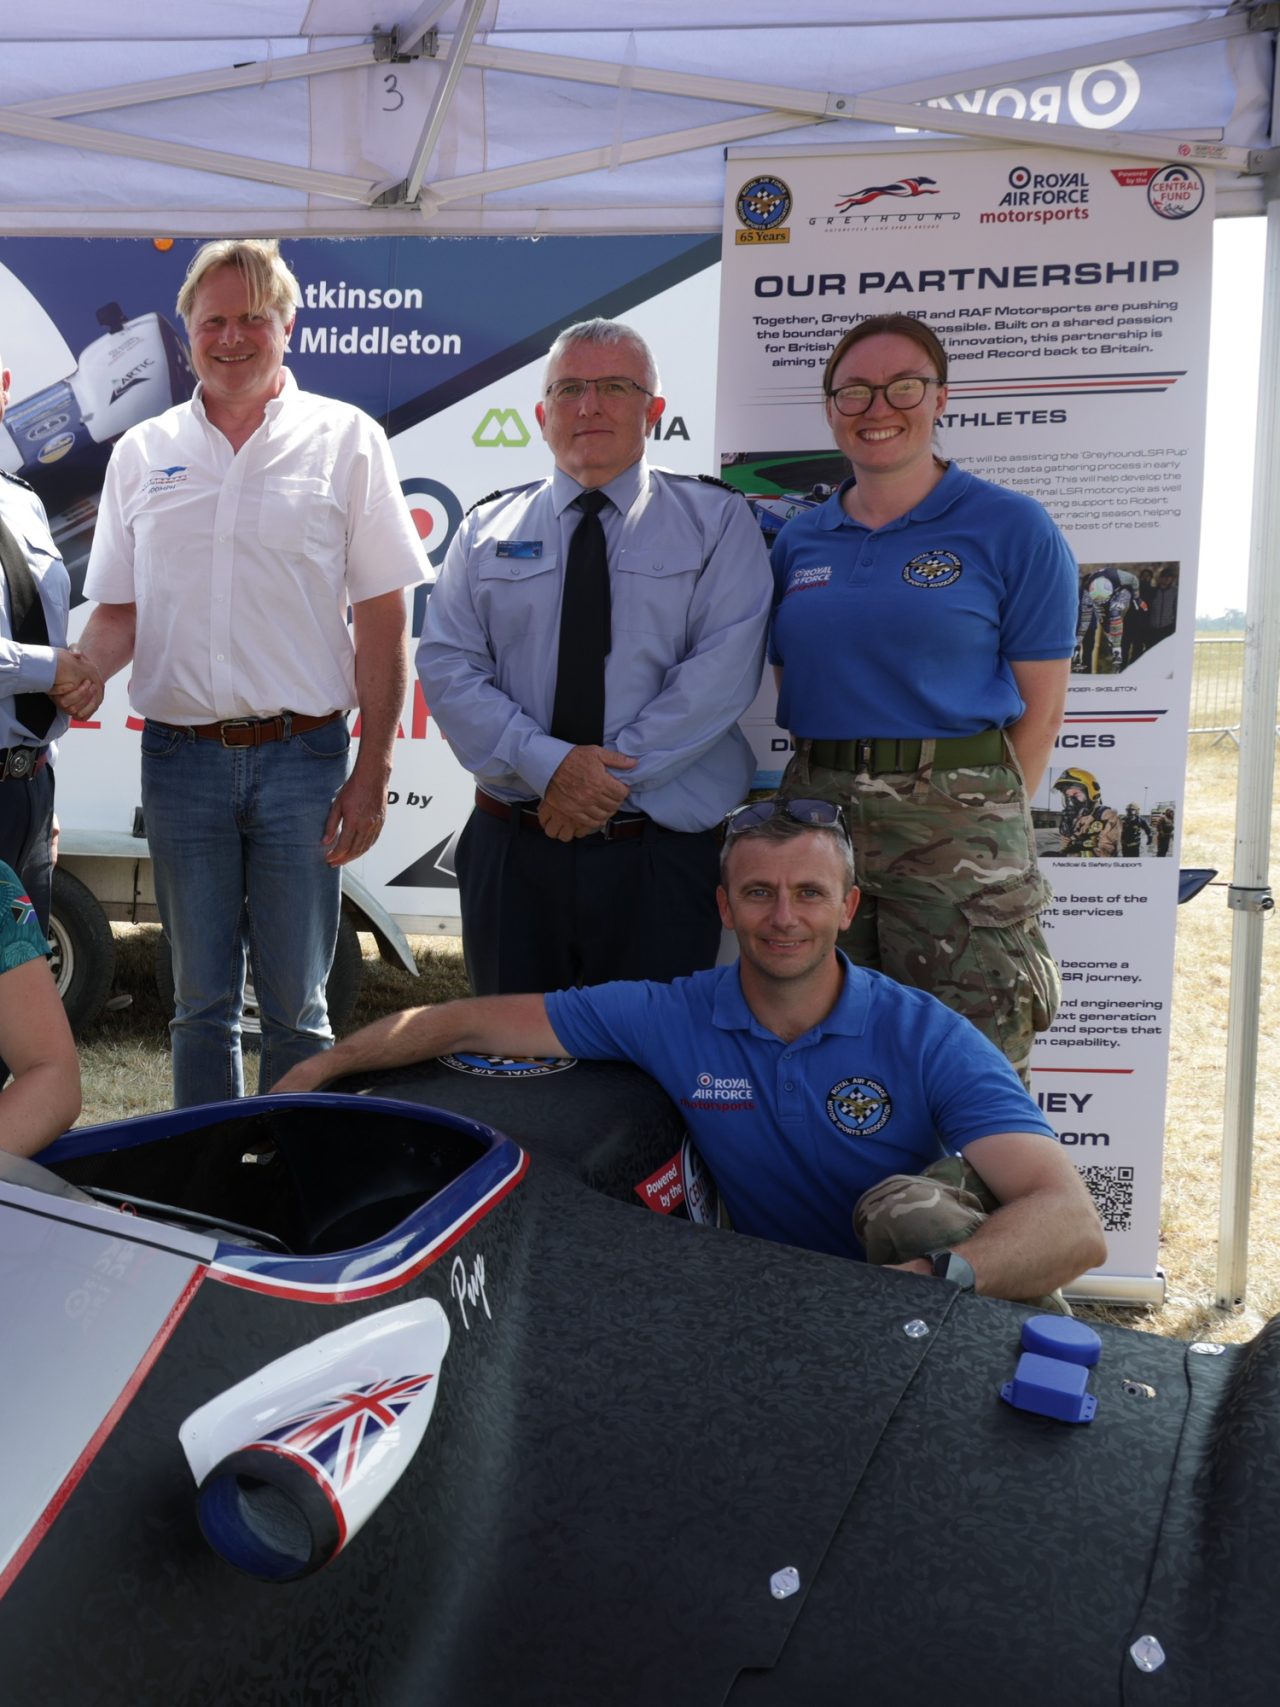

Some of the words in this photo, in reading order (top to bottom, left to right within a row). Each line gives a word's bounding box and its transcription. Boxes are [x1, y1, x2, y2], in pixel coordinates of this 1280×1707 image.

[382, 74, 404, 112] 3
[1033, 173, 1089, 189] ROYAL
[1152, 182, 1200, 193] CENTRAL
[998, 191, 1029, 207] AIR
[1032, 189, 1089, 206] FORCE
[1160, 192, 1191, 202] FUND
[808, 212, 961, 226] GREYHOUND
[979, 207, 1089, 225] motorsports
[740, 232, 754, 242] 65
[756, 231, 786, 241] Years
[754, 273, 847, 298] OUR
[858, 259, 1180, 295] PARTNERSHIP
[753, 315, 819, 328] Together,
[929, 309, 956, 320] and
[958, 307, 992, 319] RAF
[994, 302, 1092, 318] Motorsports
[1094, 303, 1119, 312] are
[1122, 300, 1178, 313] pushing
[757, 329, 780, 339] the
[782, 326, 849, 339] boundari
[995, 318, 1029, 332] Built
[1030, 321, 1048, 330] on
[1051, 320, 1060, 328] a
[1063, 316, 1113, 327] shared
[1116, 315, 1173, 328] passion
[299, 326, 462, 355] Middleton
[765, 342, 786, 353] for
[788, 340, 835, 352] British
[949, 334, 1028, 348] innovation,
[1031, 332, 1058, 343] this
[1061, 329, 1148, 345] partnership
[1151, 329, 1163, 338] is
[772, 356, 816, 369] aiming
[987, 346, 1041, 359] Record
[1044, 346, 1078, 357] back
[1081, 345, 1098, 355] to
[1100, 343, 1154, 355] Britain.
[976, 455, 993, 463] will
[994, 454, 1008, 463] be
[1009, 451, 1059, 465] assisting
[1060, 451, 1078, 460] the
[998, 465, 1016, 474] the
[1017, 464, 1043, 474] data
[1044, 462, 1096, 476] gathering
[1097, 462, 1142, 475] process
[1154, 460, 1181, 471] early
[1055, 475, 1078, 484] This
[1080, 474, 1097, 483] will
[1097, 473, 1119, 485] help
[1120, 472, 1162, 484] develop
[1163, 472, 1182, 481] the
[1036, 487, 1058, 496] final
[1059, 486, 1083, 496] LSR
[1084, 485, 1145, 497] motorcycle
[1147, 485, 1160, 493] as
[1162, 484, 1182, 493] well
[1071, 497, 1115, 509] support
[1116, 497, 1128, 506] to
[1129, 496, 1168, 505] Robert
[1066, 511, 1100, 522] racing
[1143, 508, 1182, 520] helping
[1074, 521, 1101, 531] best
[1102, 521, 1113, 530] of
[1114, 521, 1133, 530] the
[804, 566, 833, 577] ROYAL
[800, 573, 833, 585] FORCE
[406, 791, 434, 809] by
[1070, 894, 1104, 903] best
[1106, 894, 1121, 903] of
[1124, 894, 1148, 904] the
[1062, 907, 1124, 917] services
[1061, 959, 1118, 969] become
[1085, 972, 1142, 984] journey.
[1080, 999, 1163, 1011] engineering
[1055, 1012, 1077, 1021] ext
[1079, 1012, 1157, 1023] generation
[1049, 1024, 1076, 1034] and
[1078, 1025, 1129, 1036] sports
[1131, 1026, 1162, 1036] that
[1049, 1037, 1121, 1050] capability.
[472, 1067, 496, 1075] AIR
[503, 1067, 551, 1076] ROYAL
[714, 1078, 753, 1089] ROYAL
[831, 1080, 850, 1095] ROYAL
[866, 1080, 887, 1098] FORCE
[692, 1089, 713, 1100] AIR
[714, 1089, 753, 1100] FORCE
[827, 1100, 838, 1122] MOTOR
[835, 1121, 861, 1136] SPORTS
[862, 1104, 891, 1136] ASSOCIATION
[645, 1164, 679, 1198] Powered
[660, 1191, 671, 1208] by
[669, 1182, 683, 1201] the
